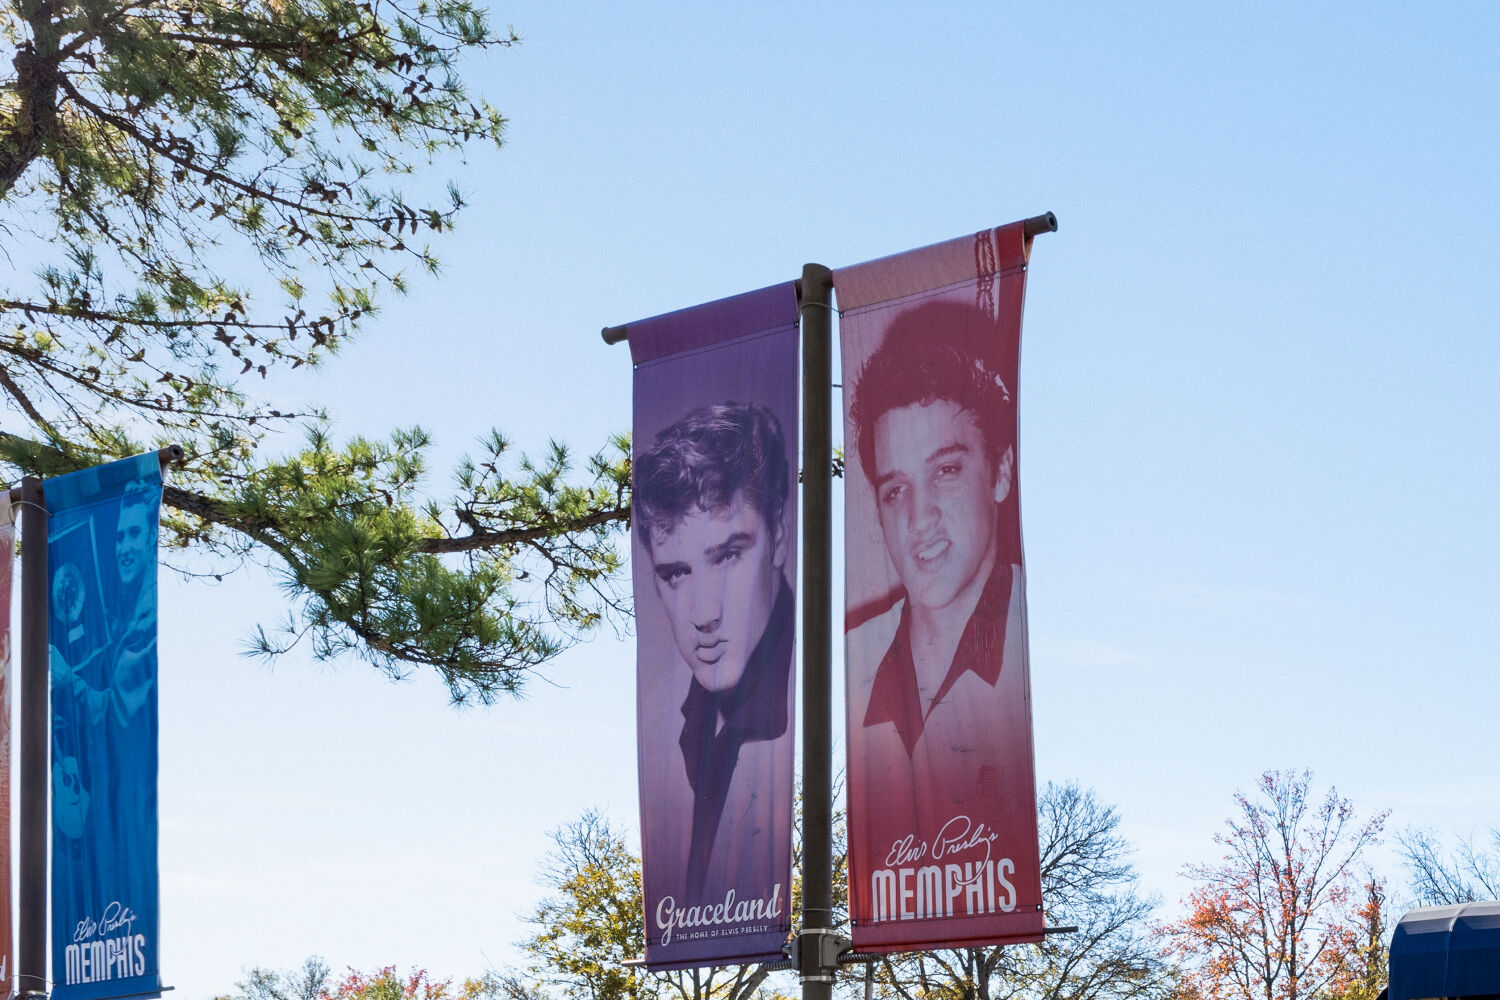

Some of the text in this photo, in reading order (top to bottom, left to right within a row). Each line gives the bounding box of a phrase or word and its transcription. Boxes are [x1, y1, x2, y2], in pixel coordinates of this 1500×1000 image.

[885, 834, 928, 867] Elvis
[656, 883, 782, 947] Graceland
[872, 857, 1017, 923] MEMPHIS
[65, 933, 146, 985] MEMPHIS
[676, 933, 688, 941] THE
[711, 929, 720, 937] OF
[721, 928, 739, 936] ELVIS
